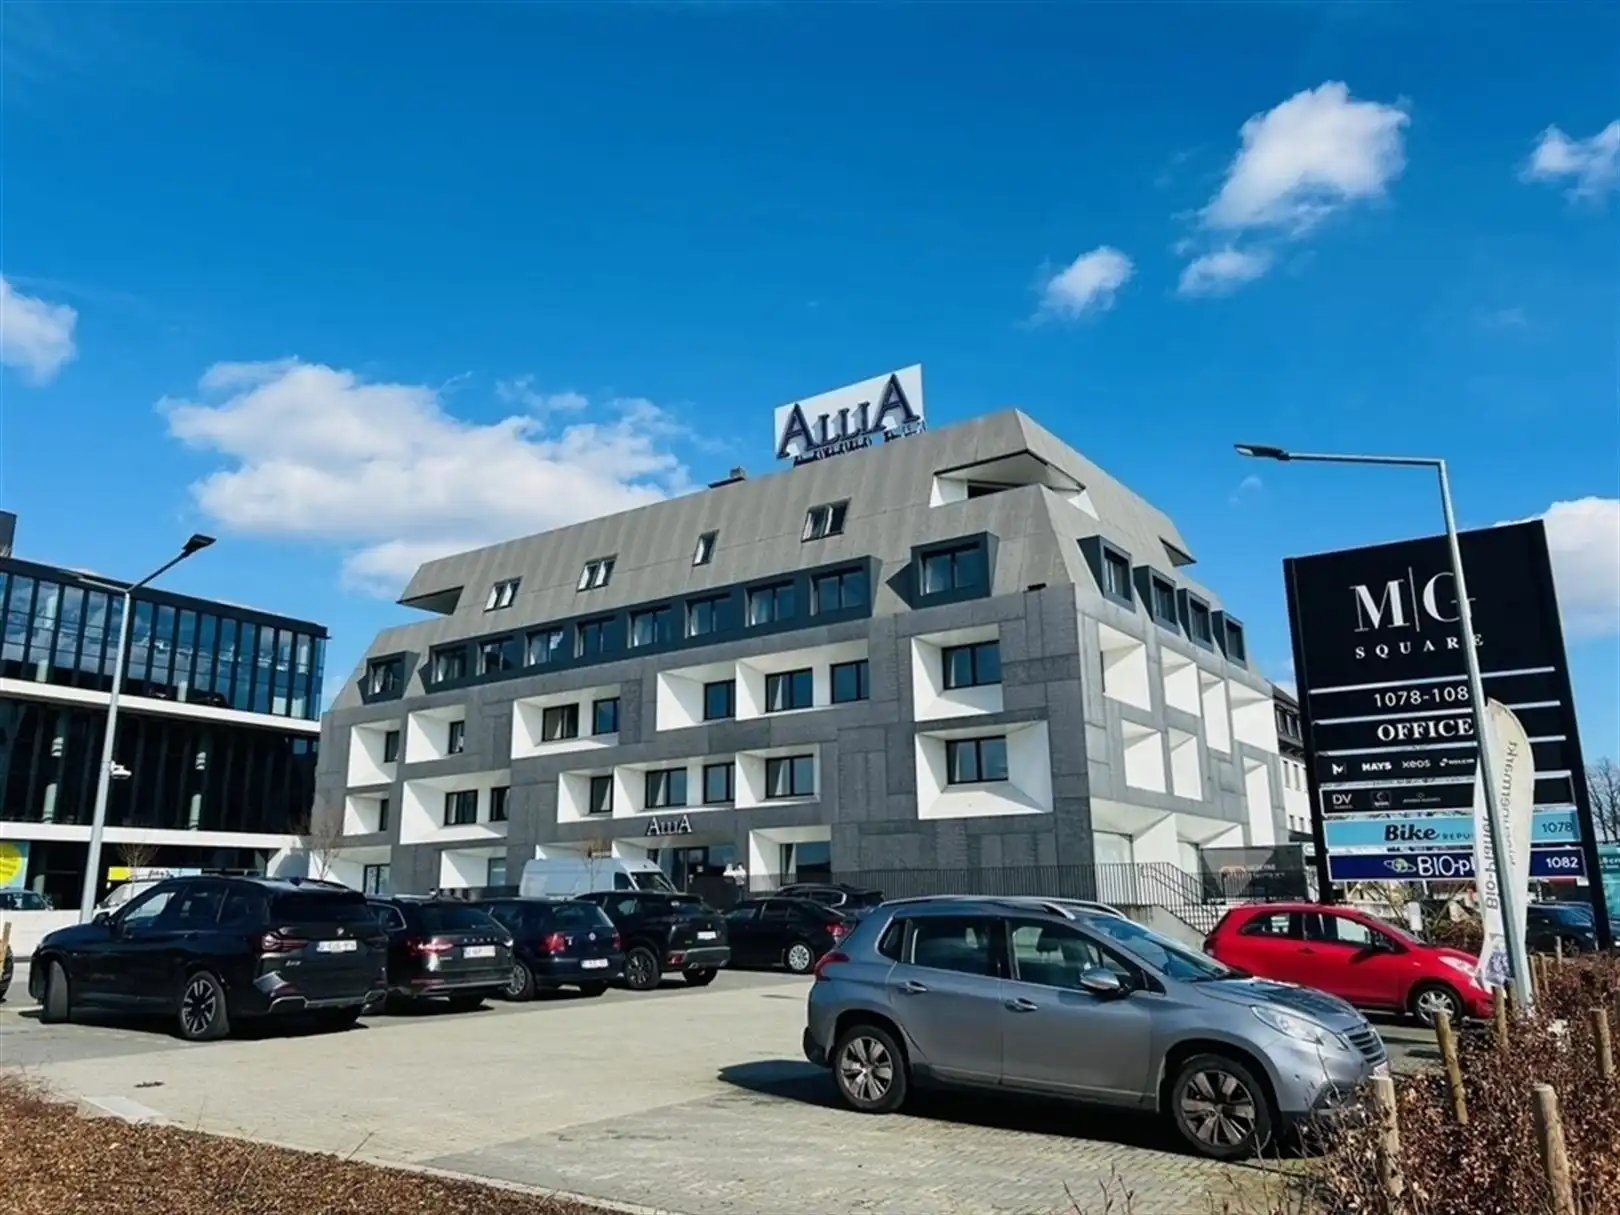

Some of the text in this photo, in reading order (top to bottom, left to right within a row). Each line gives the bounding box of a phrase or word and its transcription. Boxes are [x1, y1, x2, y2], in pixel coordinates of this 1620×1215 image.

[1354, 633, 1484, 660] SQUARE
[1373, 685, 1470, 708] 1078-108
[1361, 761, 1392, 772] HAYS
[1332, 793, 1352, 805] DV
[1384, 821, 1574, 841] Bike REPU 1078
[1417, 855, 1579, 876] BIO-pl 1082
